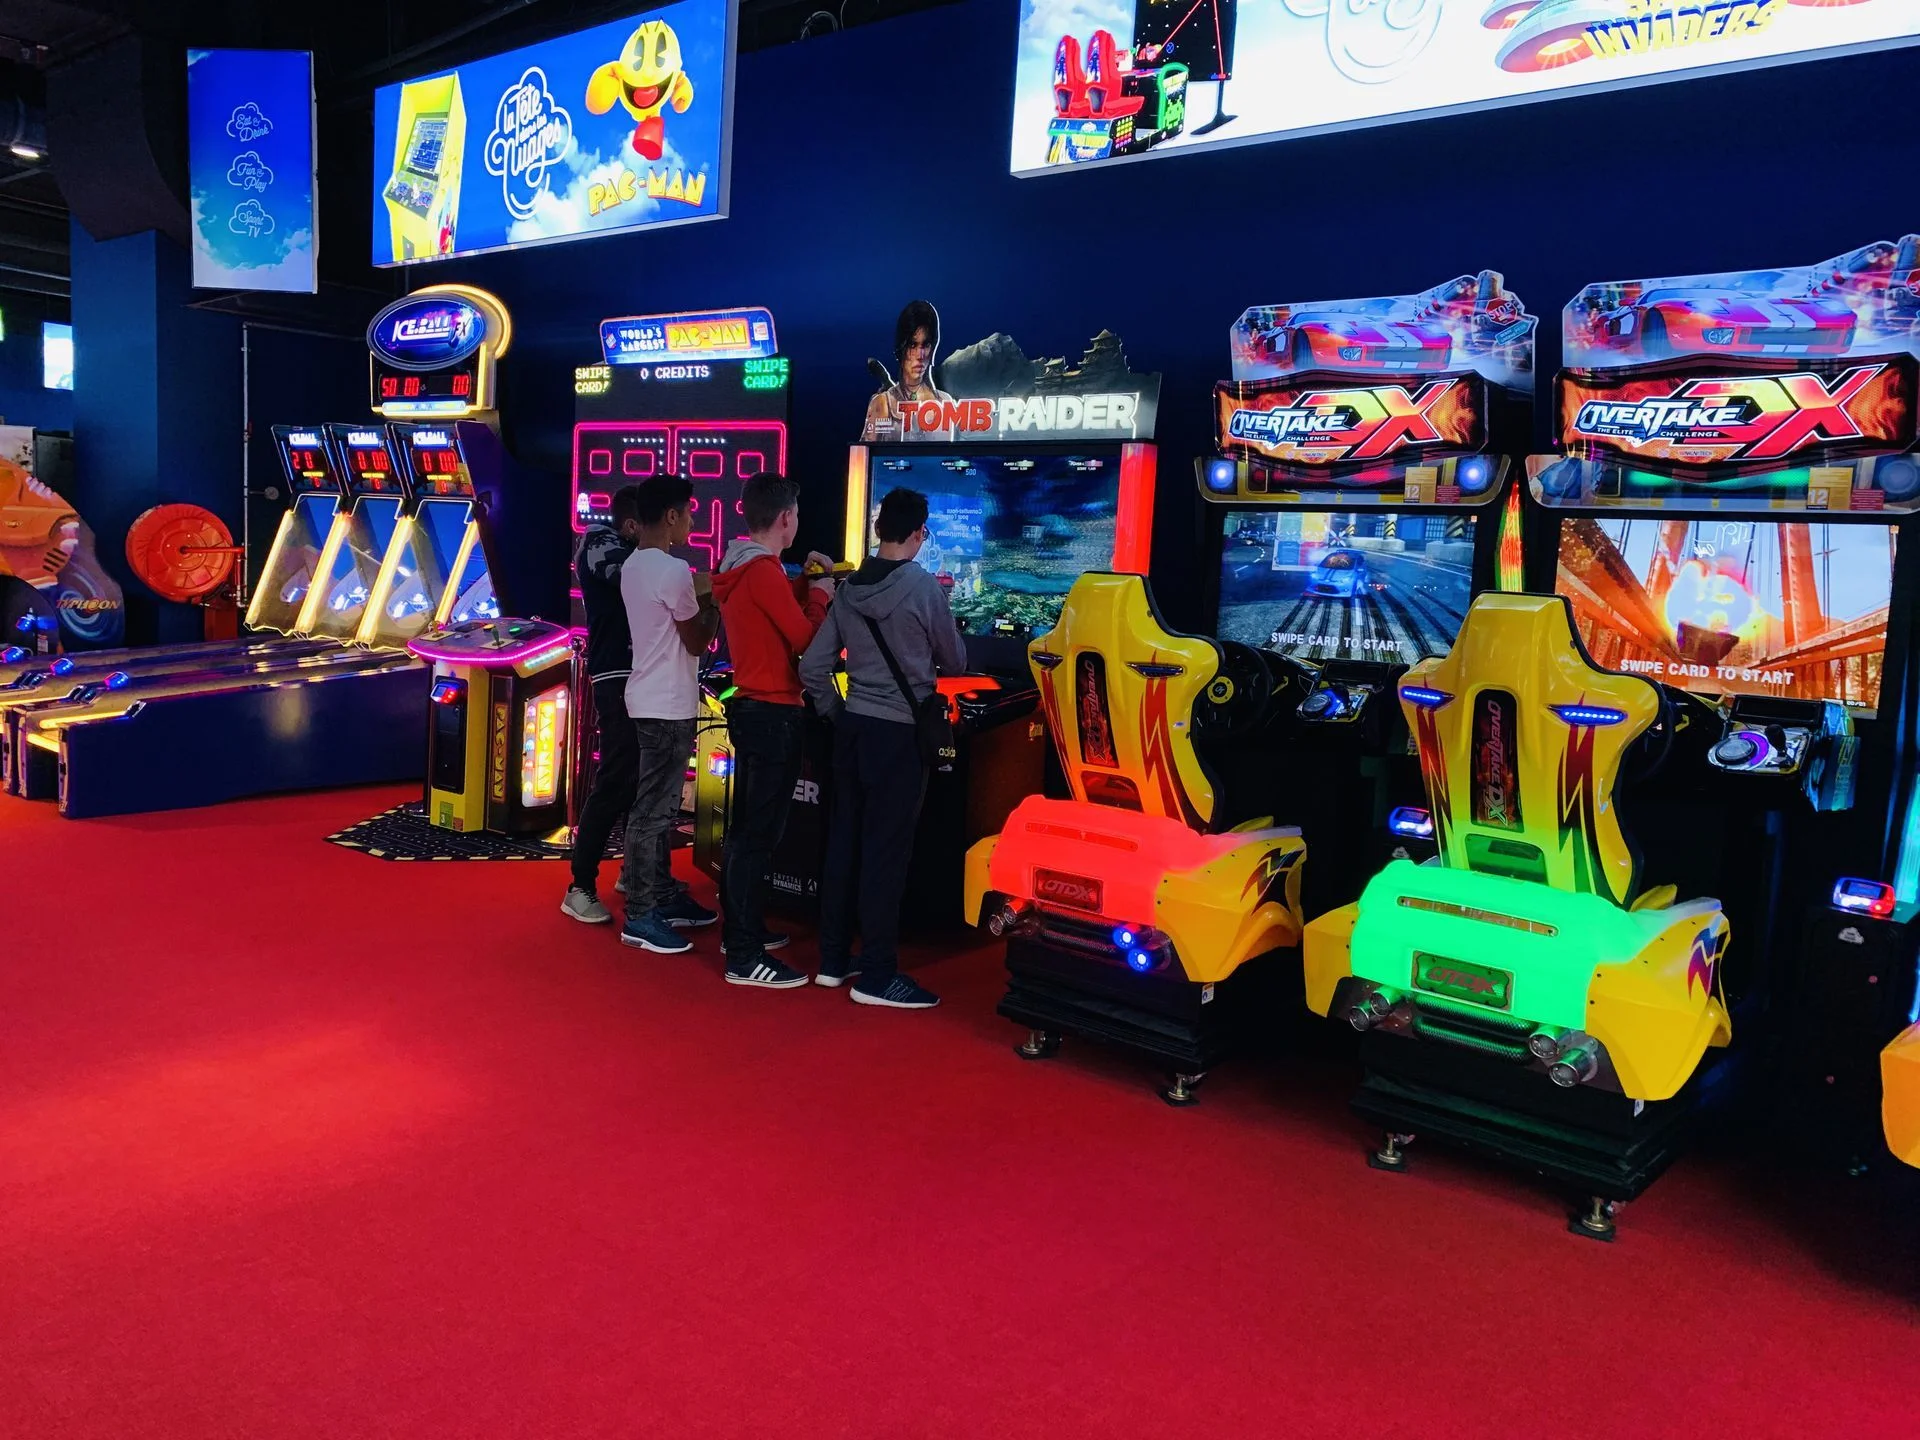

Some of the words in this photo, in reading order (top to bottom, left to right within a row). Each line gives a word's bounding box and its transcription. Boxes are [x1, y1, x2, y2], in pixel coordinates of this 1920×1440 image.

[1581, 1, 1779, 59] INVADERS
[235, 114, 252, 130] Eat
[504, 104, 515, 134] la
[240, 124, 269, 142] Drink
[492, 117, 562, 187] Nuages
[237, 163, 255, 176] Fun
[244, 176, 267, 192] Play
[588, 166, 706, 216] PAC-MAN
[249, 225, 260, 238] TV
[1489, 302, 1512, 319] STOP
[619, 328, 662, 340] WORLD'S
[668, 324, 748, 348] PAC-MAN
[621, 339, 665, 351] LARGEST
[575, 367, 611, 379] SWIPE
[655, 366, 710, 379] CREDITS
[745, 359, 788, 373] SWIPE
[575, 382, 609, 393] CARD!
[744, 375, 787, 388] CARD!
[899, 400, 993, 432] TOMB
[1000, 395, 1135, 431] RAIDER
[1232, 410, 1350, 440] OVERTAKE
[1301, 380, 1457, 459] DX
[1580, 401, 1744, 437] OVERTAKE
[1682, 363, 1887, 459] DX
[1405, 485, 1420, 499] 12
[1808, 488, 1829, 505] 12
[56, 599, 120, 611] TYPHOON
[1271, 632, 1304, 644] SWIPE
[1308, 635, 1339, 647] CARD
[1344, 637, 1359, 648] TO
[1364, 639, 1402, 652] START
[1620, 658, 1663, 674] SWIPE
[1668, 662, 1710, 678] CARD
[1716, 666, 1736, 680] TO
[1742, 670, 1794, 685] START
[536, 702, 555, 794] PAC-MAN
[1487, 700, 1503, 783] OVERTAKE
[493, 706, 506, 798] PAC-MAN
[1045, 880, 1091, 901] OTDX
[1428, 966, 1498, 994] OTDX
